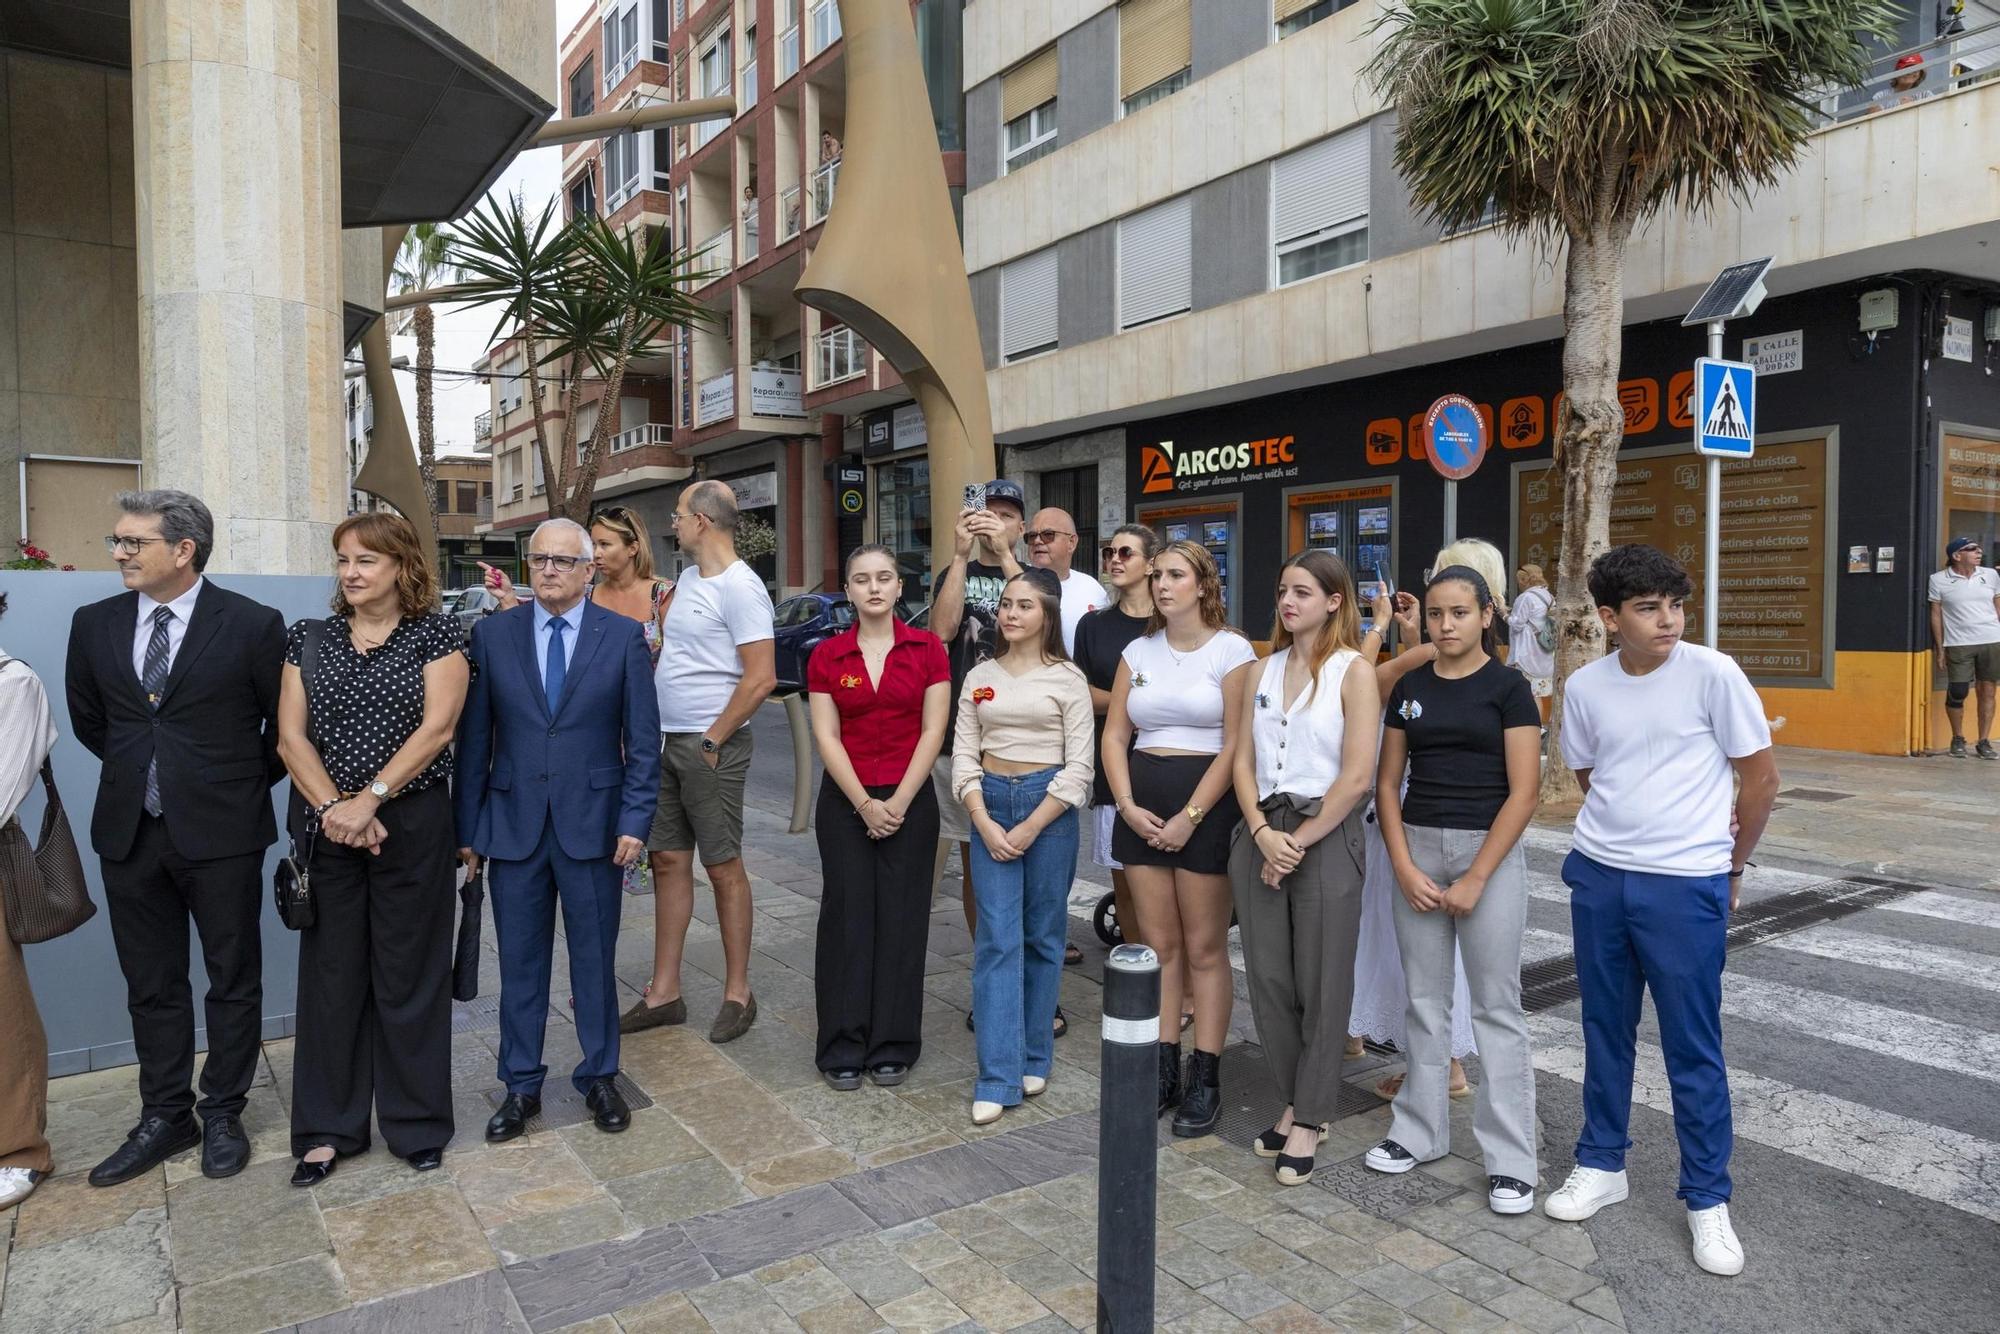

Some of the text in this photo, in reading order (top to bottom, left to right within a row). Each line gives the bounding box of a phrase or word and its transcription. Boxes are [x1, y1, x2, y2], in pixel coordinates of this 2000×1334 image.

[1763, 337, 1799, 350] CALLE
[1765, 360, 1796, 372] RODAS
[1428, 399, 1448, 427] EXCEPTO
[1175, 435, 1295, 477] ARCOSTEC
[1753, 455, 1797, 468] turística
[1178, 480, 1193, 491] Get
[1193, 479, 1209, 491] your
[1212, 474, 1238, 486] dream
[1240, 471, 1264, 482] home
[1264, 468, 1284, 479] with
[1616, 469, 1652, 482] pación
[1720, 494, 1799, 508] encias de obra
[1720, 512, 1812, 526] struction work permits
[1719, 535, 1809, 548] letines eléctricos
[1745, 575, 1806, 586] urbanística
[1735, 593, 1798, 604] managements
[1718, 610, 1756, 621] oyectos
[1766, 609, 1802, 619] Diseño
[1759, 627, 1788, 638] design
[1743, 656, 1761, 665] 865
